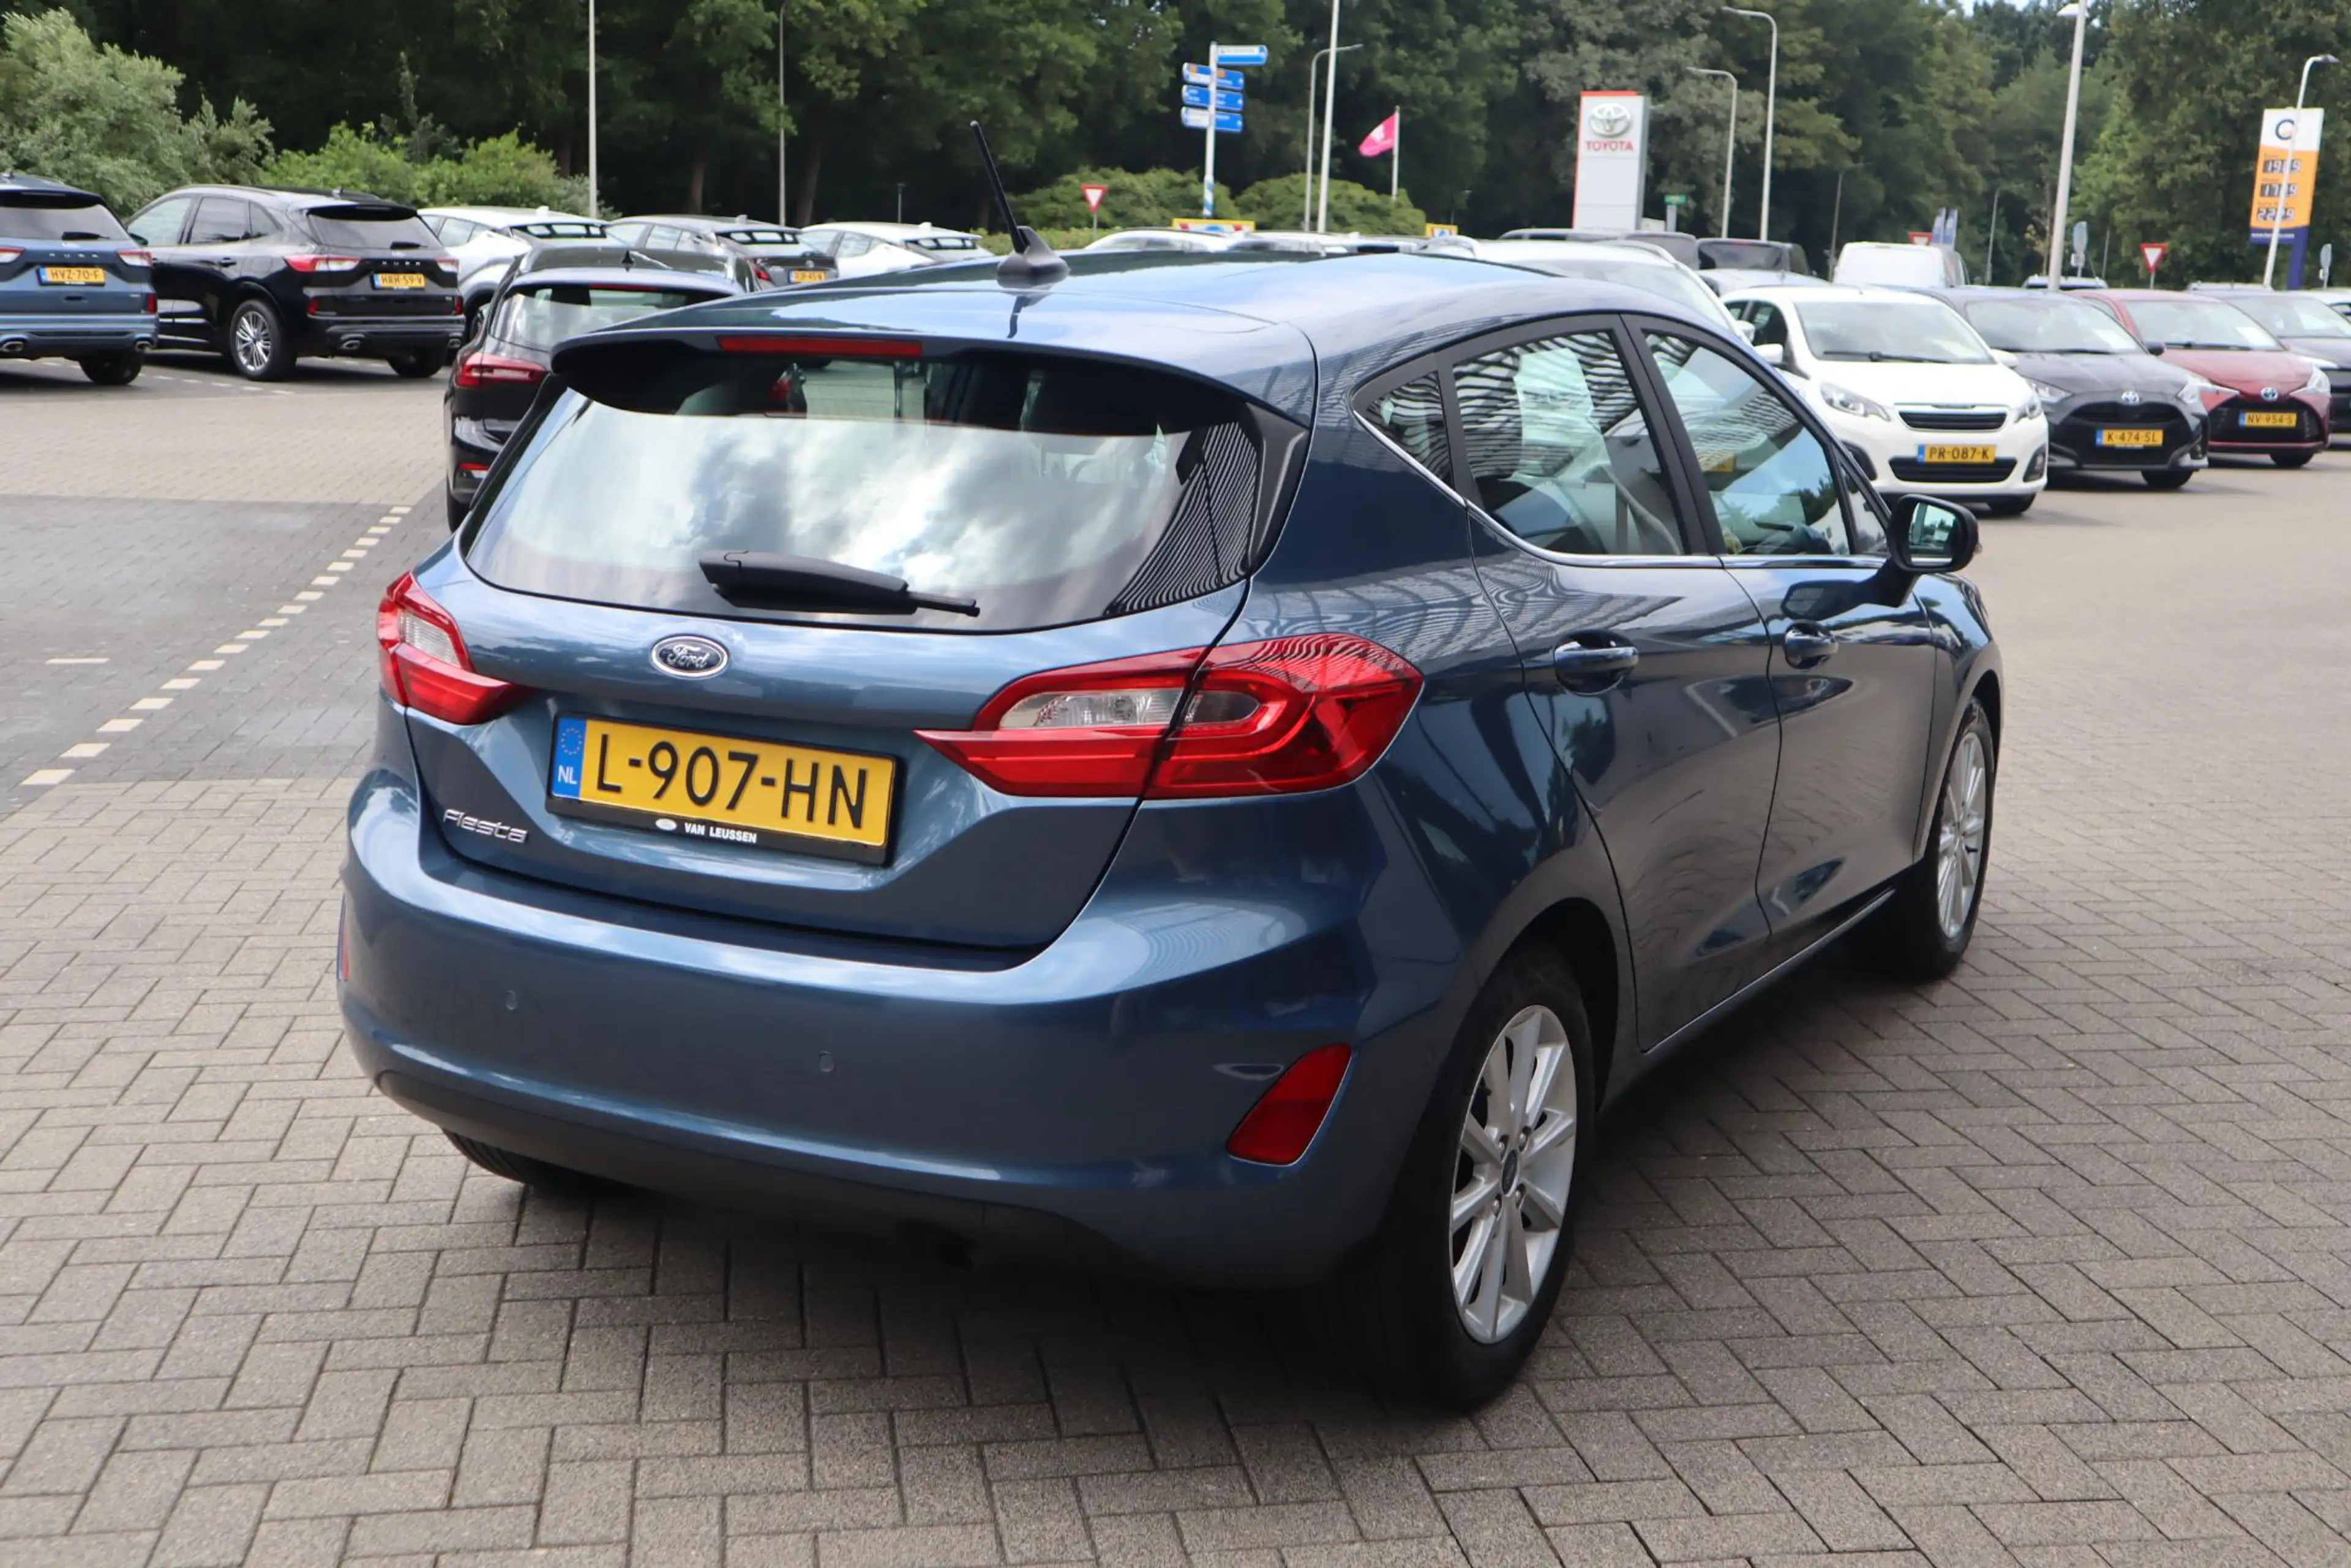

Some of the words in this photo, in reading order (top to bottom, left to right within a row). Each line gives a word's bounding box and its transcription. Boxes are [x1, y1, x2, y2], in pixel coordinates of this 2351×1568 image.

[1584, 140, 1634, 152] TOYOTA
[2107, 431, 2158, 443] K-474-SL
[1929, 446, 1990, 460] PR-087-K
[667, 644, 710, 669] Ford
[557, 764, 577, 785] NL
[596, 733, 868, 829] L-907-HN
[443, 808, 528, 844] Fiesta
[684, 822, 706, 836] VAN
[709, 827, 758, 844] LEUSSEN
